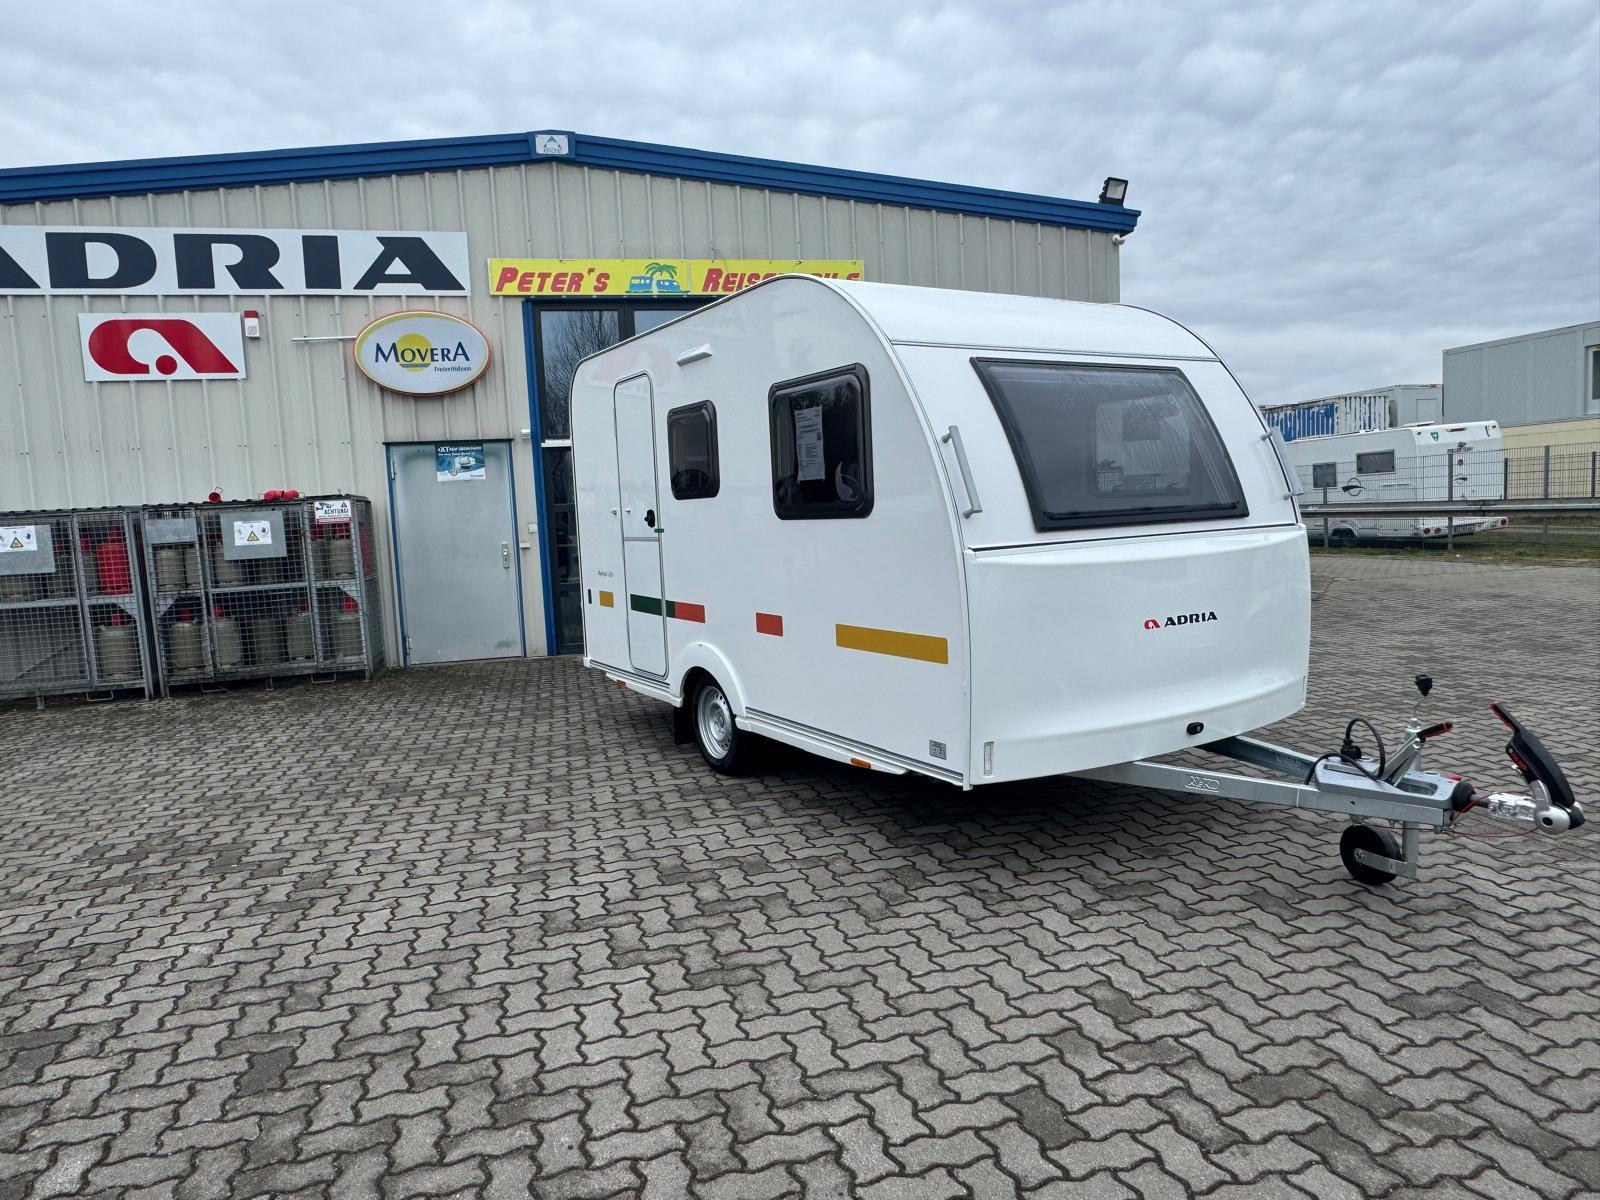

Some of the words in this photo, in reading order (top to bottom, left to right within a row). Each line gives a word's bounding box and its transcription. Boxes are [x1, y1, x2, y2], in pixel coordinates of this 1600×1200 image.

[495, 267, 611, 292] PETER'S
[375, 341, 470, 363] MOVERA
[1164, 611, 1218, 627] ADRIA
